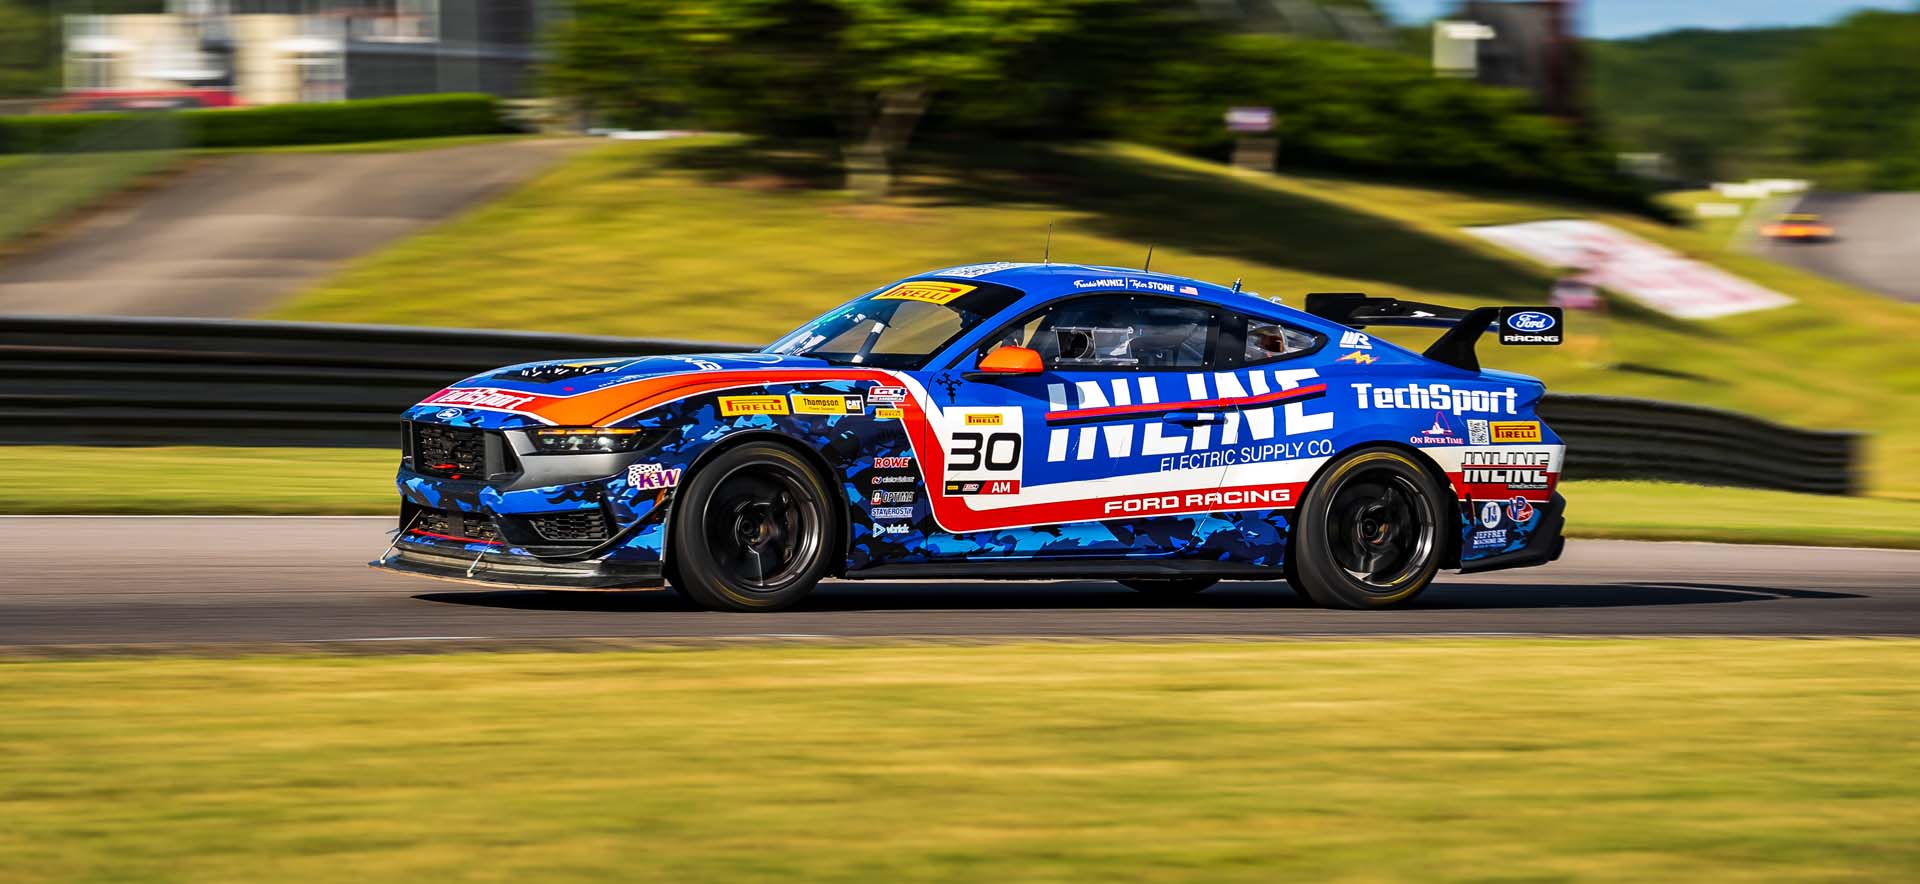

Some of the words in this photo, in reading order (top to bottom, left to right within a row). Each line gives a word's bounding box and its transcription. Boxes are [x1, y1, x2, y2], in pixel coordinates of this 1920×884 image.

[1096, 279, 1125, 287] MUNIZ
[1148, 282, 1175, 292] STONE
[884, 285, 961, 301] PIRELLI
[1516, 314, 1546, 328] Ford
[726, 399, 783, 412] PIRELLI
[803, 398, 840, 407] Thompson
[846, 400, 862, 410] CAT
[1351, 383, 1518, 416] TechSport
[967, 415, 1000, 424] PIRELLI
[1047, 368, 1334, 462] INLINE
[1494, 425, 1536, 439] PIRELLI
[947, 432, 1022, 471] 30
[1160, 449, 1236, 472] ELECTRIC
[1240, 441, 1304, 464] SUPPLY
[1307, 438, 1336, 456] CO.
[874, 457, 911, 469] ROWE
[1463, 452, 1550, 484] INLINE
[638, 469, 681, 490] KW
[991, 482, 1011, 494] AM
[883, 492, 915, 503] OPTIMA
[1104, 496, 1180, 514] FORD
[1185, 489, 1291, 507] RACING
[871, 507, 887, 517] STAY
[888, 506, 913, 517] FROSTY
[1473, 529, 1507, 540] JEFFREY
